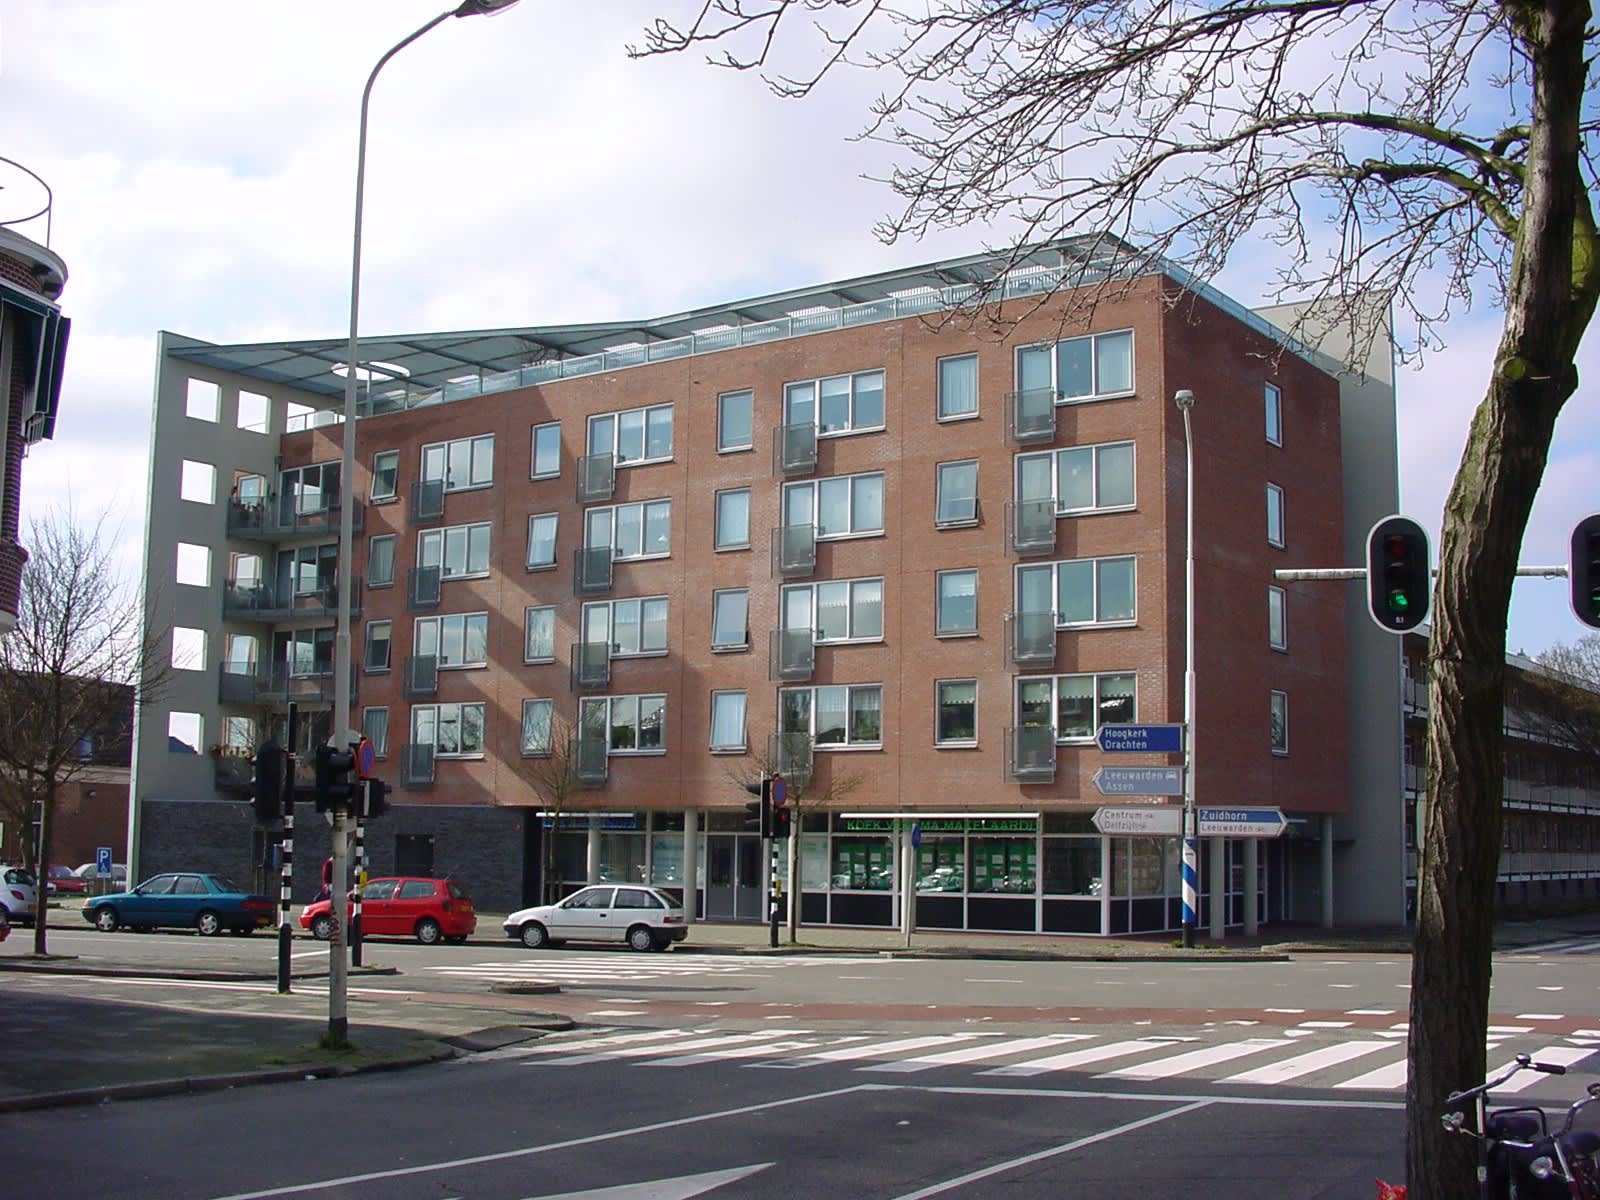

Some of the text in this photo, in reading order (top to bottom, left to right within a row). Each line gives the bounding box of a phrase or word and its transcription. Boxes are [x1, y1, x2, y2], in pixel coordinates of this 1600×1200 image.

[1105, 728, 1148, 740] Hoogkerk
[1105, 740, 1147, 749] Drachten
[1104, 771, 1163, 780] Leeuwarden
[1105, 782, 1134, 791] Assen
[1104, 811, 1142, 819] Centrum
[1201, 811, 1247, 820] Zuidhorn
[1201, 824, 1253, 832] Leeuwarden
[100, 850, 109, 863] P
